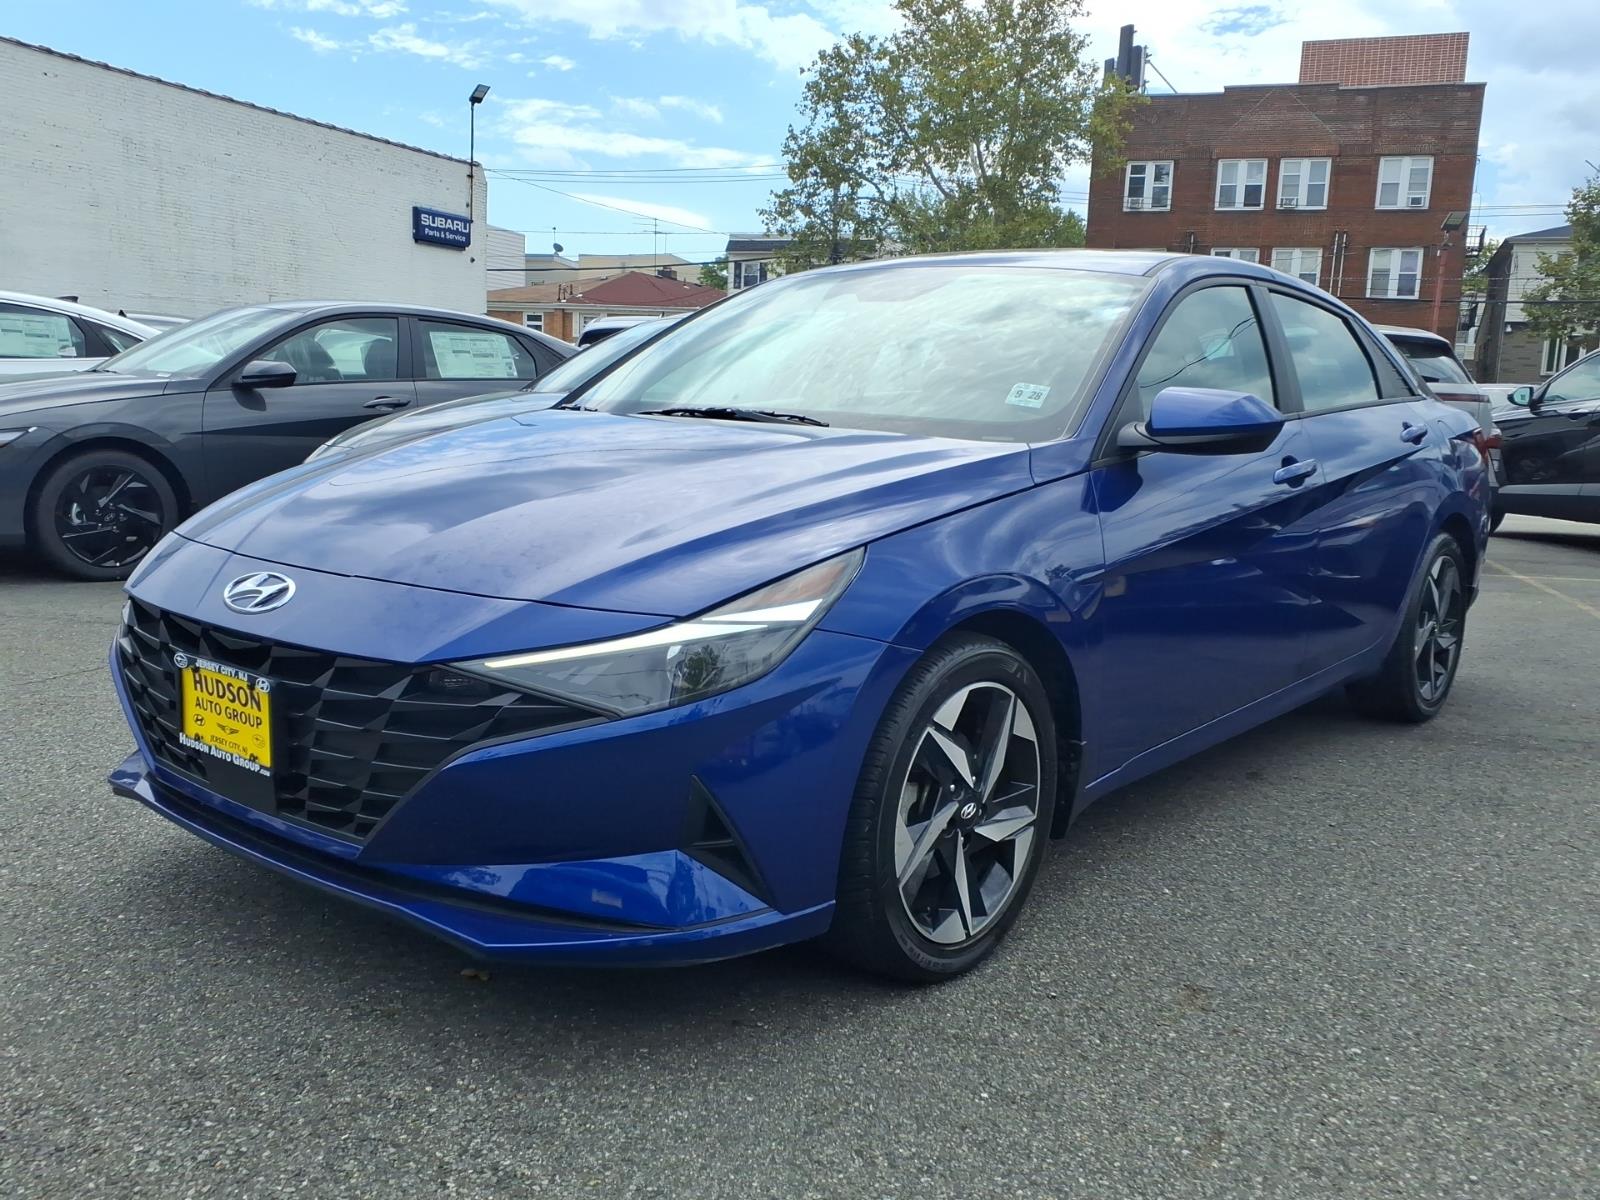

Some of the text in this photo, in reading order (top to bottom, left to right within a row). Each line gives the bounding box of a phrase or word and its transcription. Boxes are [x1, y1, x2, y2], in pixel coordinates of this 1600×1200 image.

[421, 213, 469, 233] SUBARU
[424, 228, 440, 237] Parts
[445, 231, 466, 242] Service
[192, 668, 262, 712] HUDSON
[195, 696, 263, 729] AUTO GROUP
[210, 735, 228, 747] JERSEY
